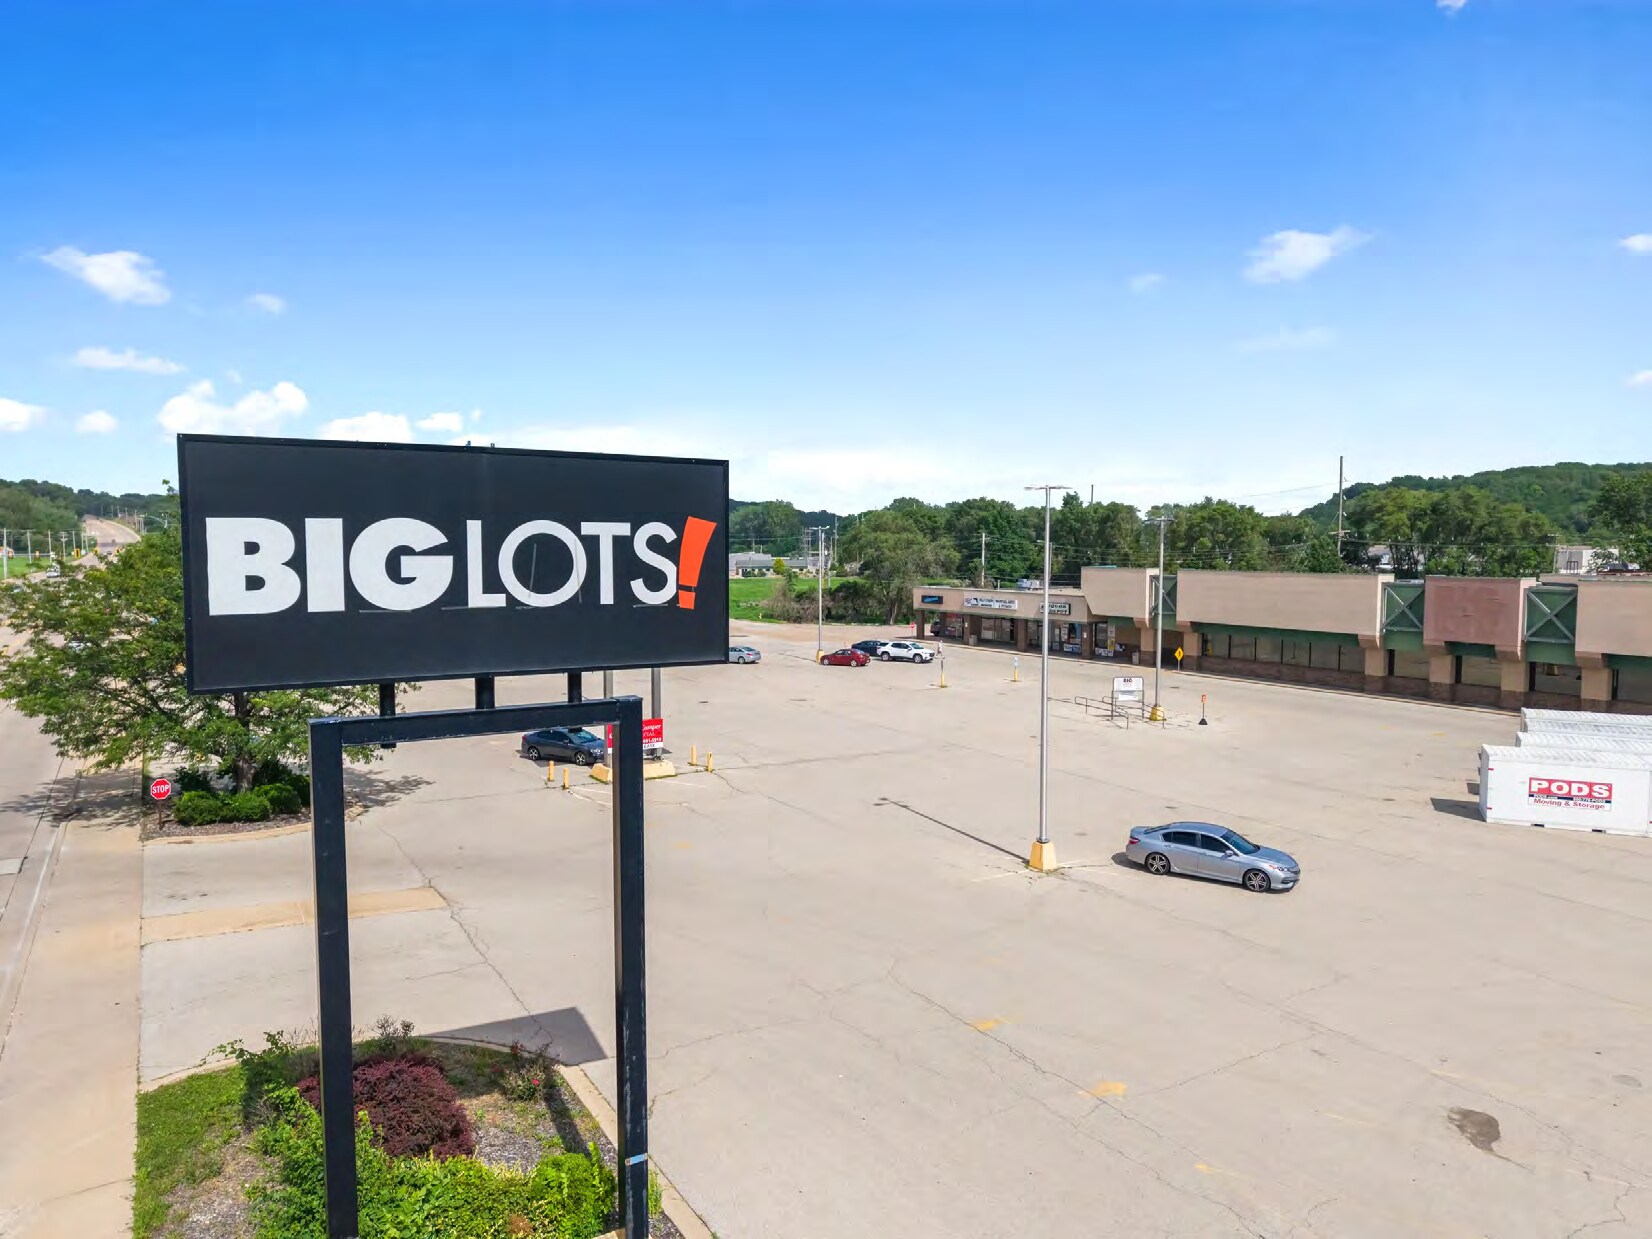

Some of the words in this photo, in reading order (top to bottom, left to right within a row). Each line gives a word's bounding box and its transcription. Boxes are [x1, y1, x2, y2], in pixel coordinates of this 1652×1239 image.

[205, 516, 454, 616] BIG
[466, 515, 717, 610] LOTS!
[152, 784, 169, 794] STOP
[1530, 779, 1610, 798] PODS
[1533, 798, 1562, 807] Moving
[1573, 801, 1605, 810] Storage
